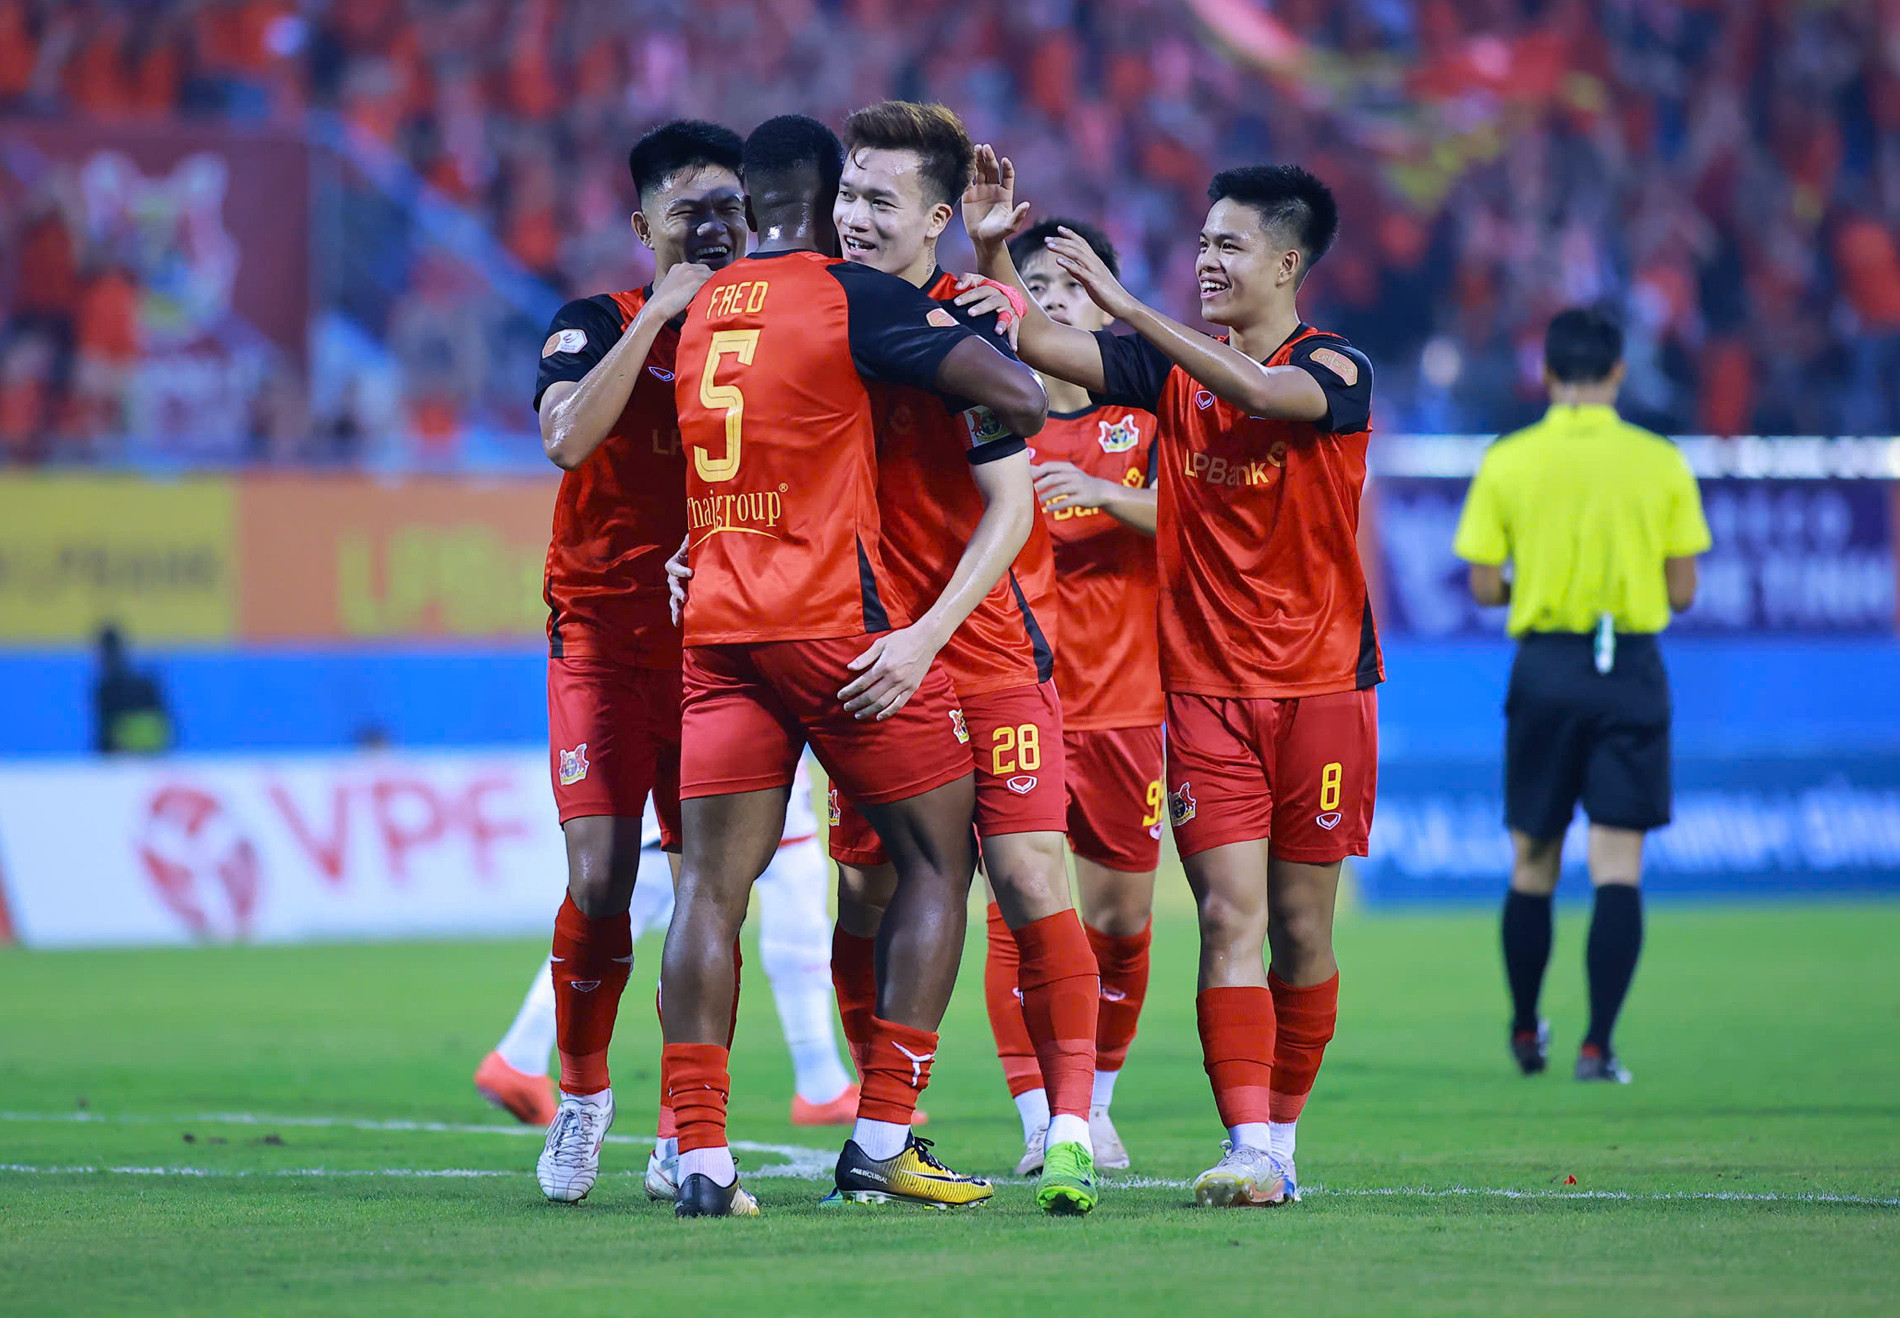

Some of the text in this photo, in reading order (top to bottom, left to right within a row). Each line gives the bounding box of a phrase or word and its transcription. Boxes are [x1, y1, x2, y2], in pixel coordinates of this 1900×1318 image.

[706, 281, 769, 320] FRED
[693, 329, 762, 483] 5
[1184, 448, 1269, 486] LPBank
[992, 723, 1041, 775] 28
[1320, 762, 1342, 811] 8
[265, 767, 530, 886] VPF
[850, 1167, 888, 1185] MERCURIAL
